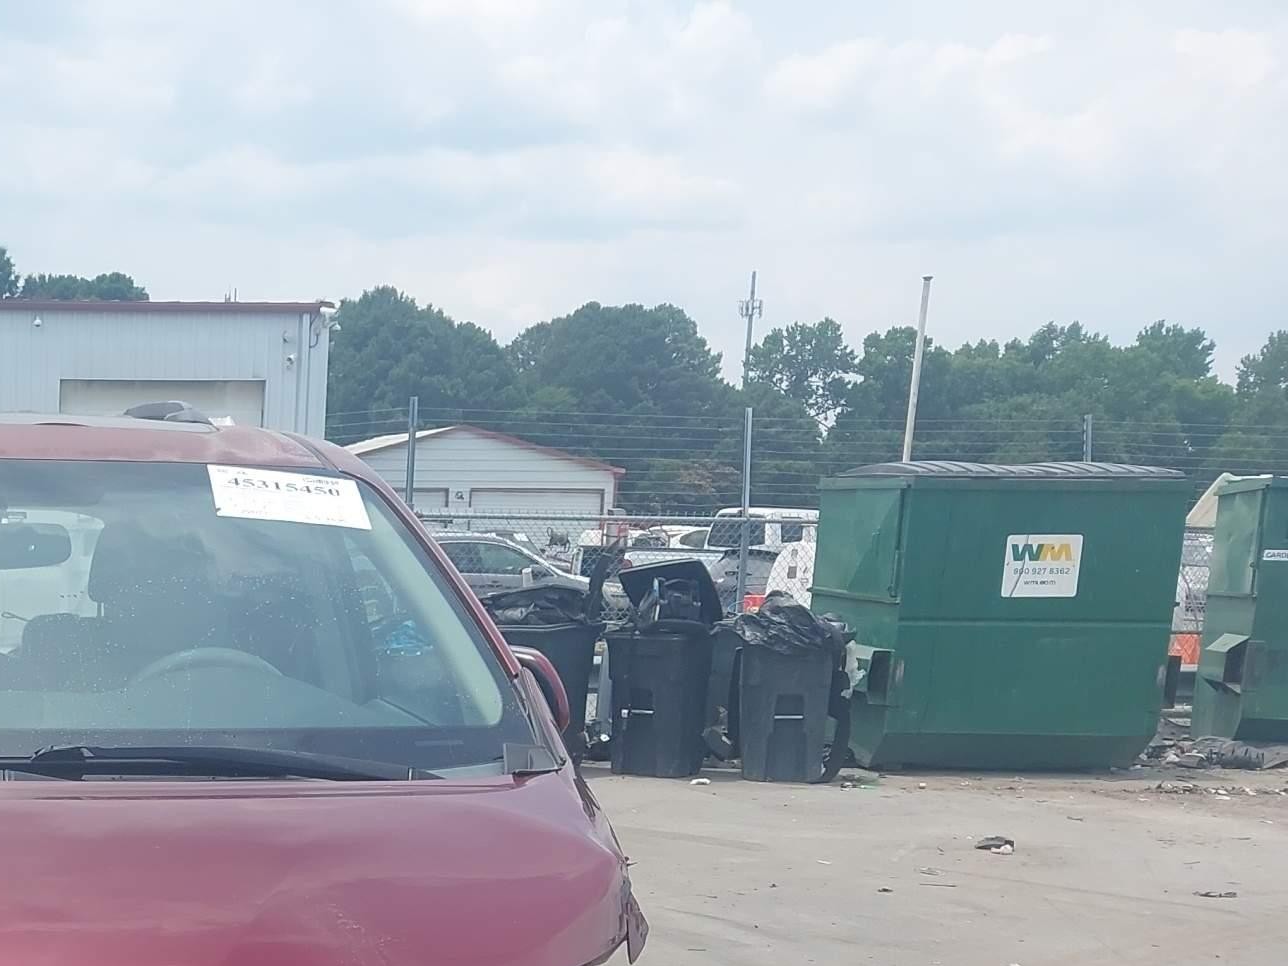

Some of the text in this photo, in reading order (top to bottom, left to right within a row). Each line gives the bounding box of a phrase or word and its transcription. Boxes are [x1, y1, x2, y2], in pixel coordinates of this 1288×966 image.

[227, 477, 341, 497] 45315450
[1011, 543, 1073, 562] WM
[1031, 567, 1047, 575] 927
